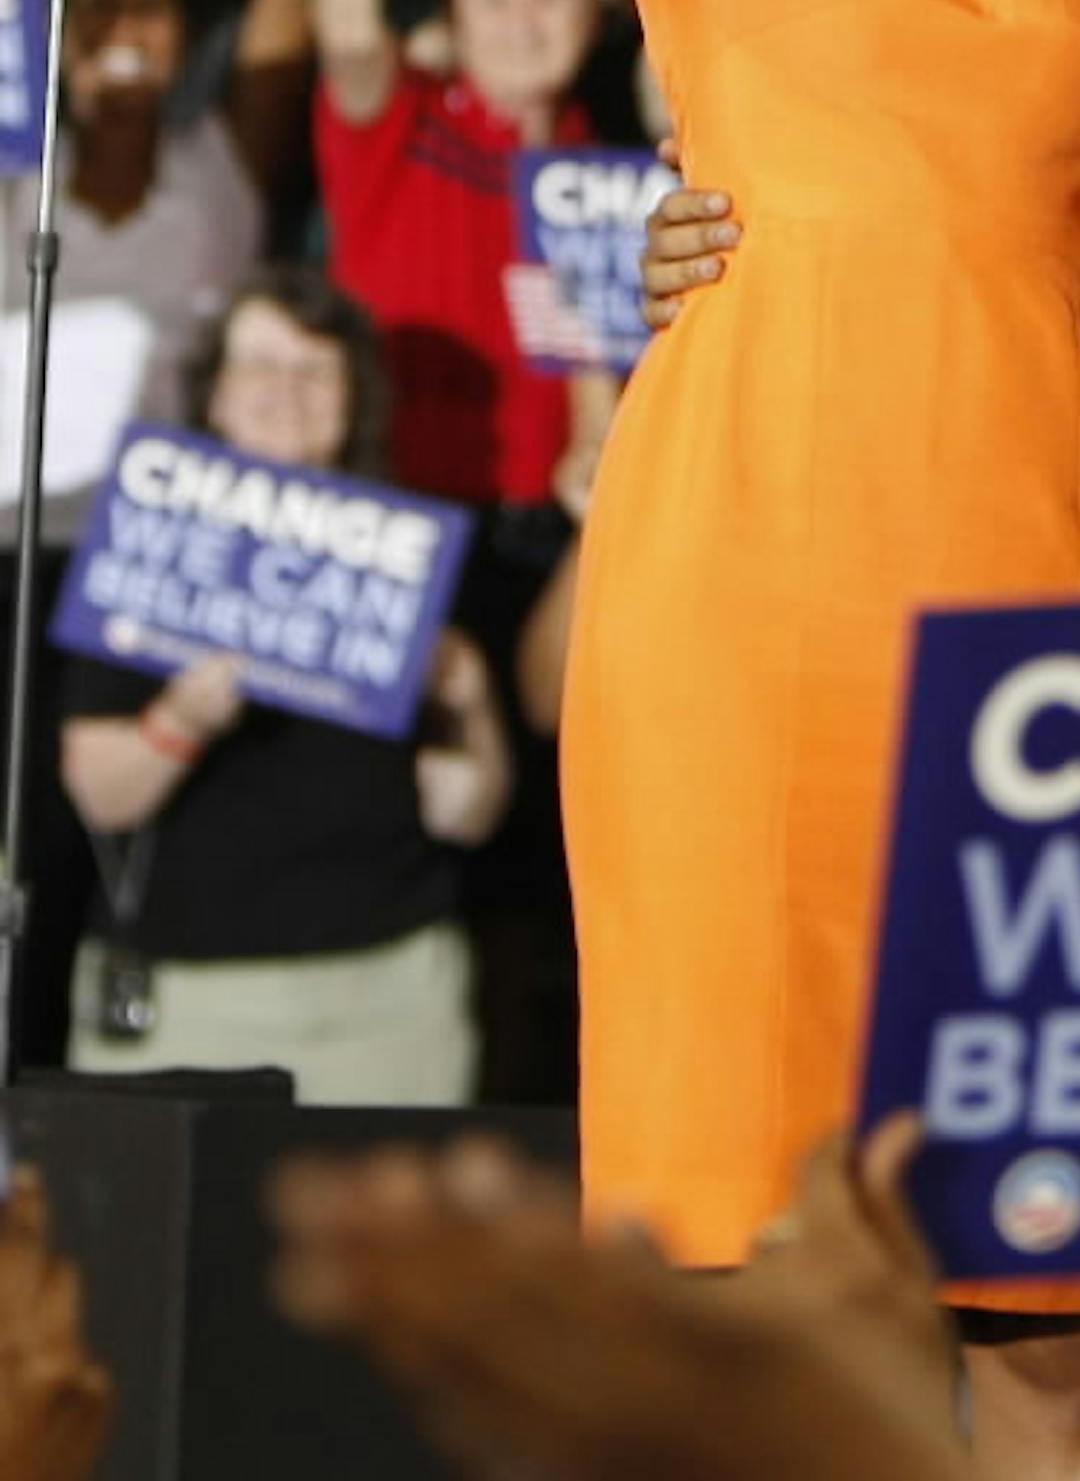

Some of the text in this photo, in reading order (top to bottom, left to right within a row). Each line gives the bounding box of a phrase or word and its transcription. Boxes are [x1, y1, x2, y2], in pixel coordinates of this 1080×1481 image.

[108, 496, 424, 638] WE CAN
[118, 438, 442, 586] CHANGE
[84, 552, 326, 668] BELIEVE
[330, 628, 404, 690] IN
